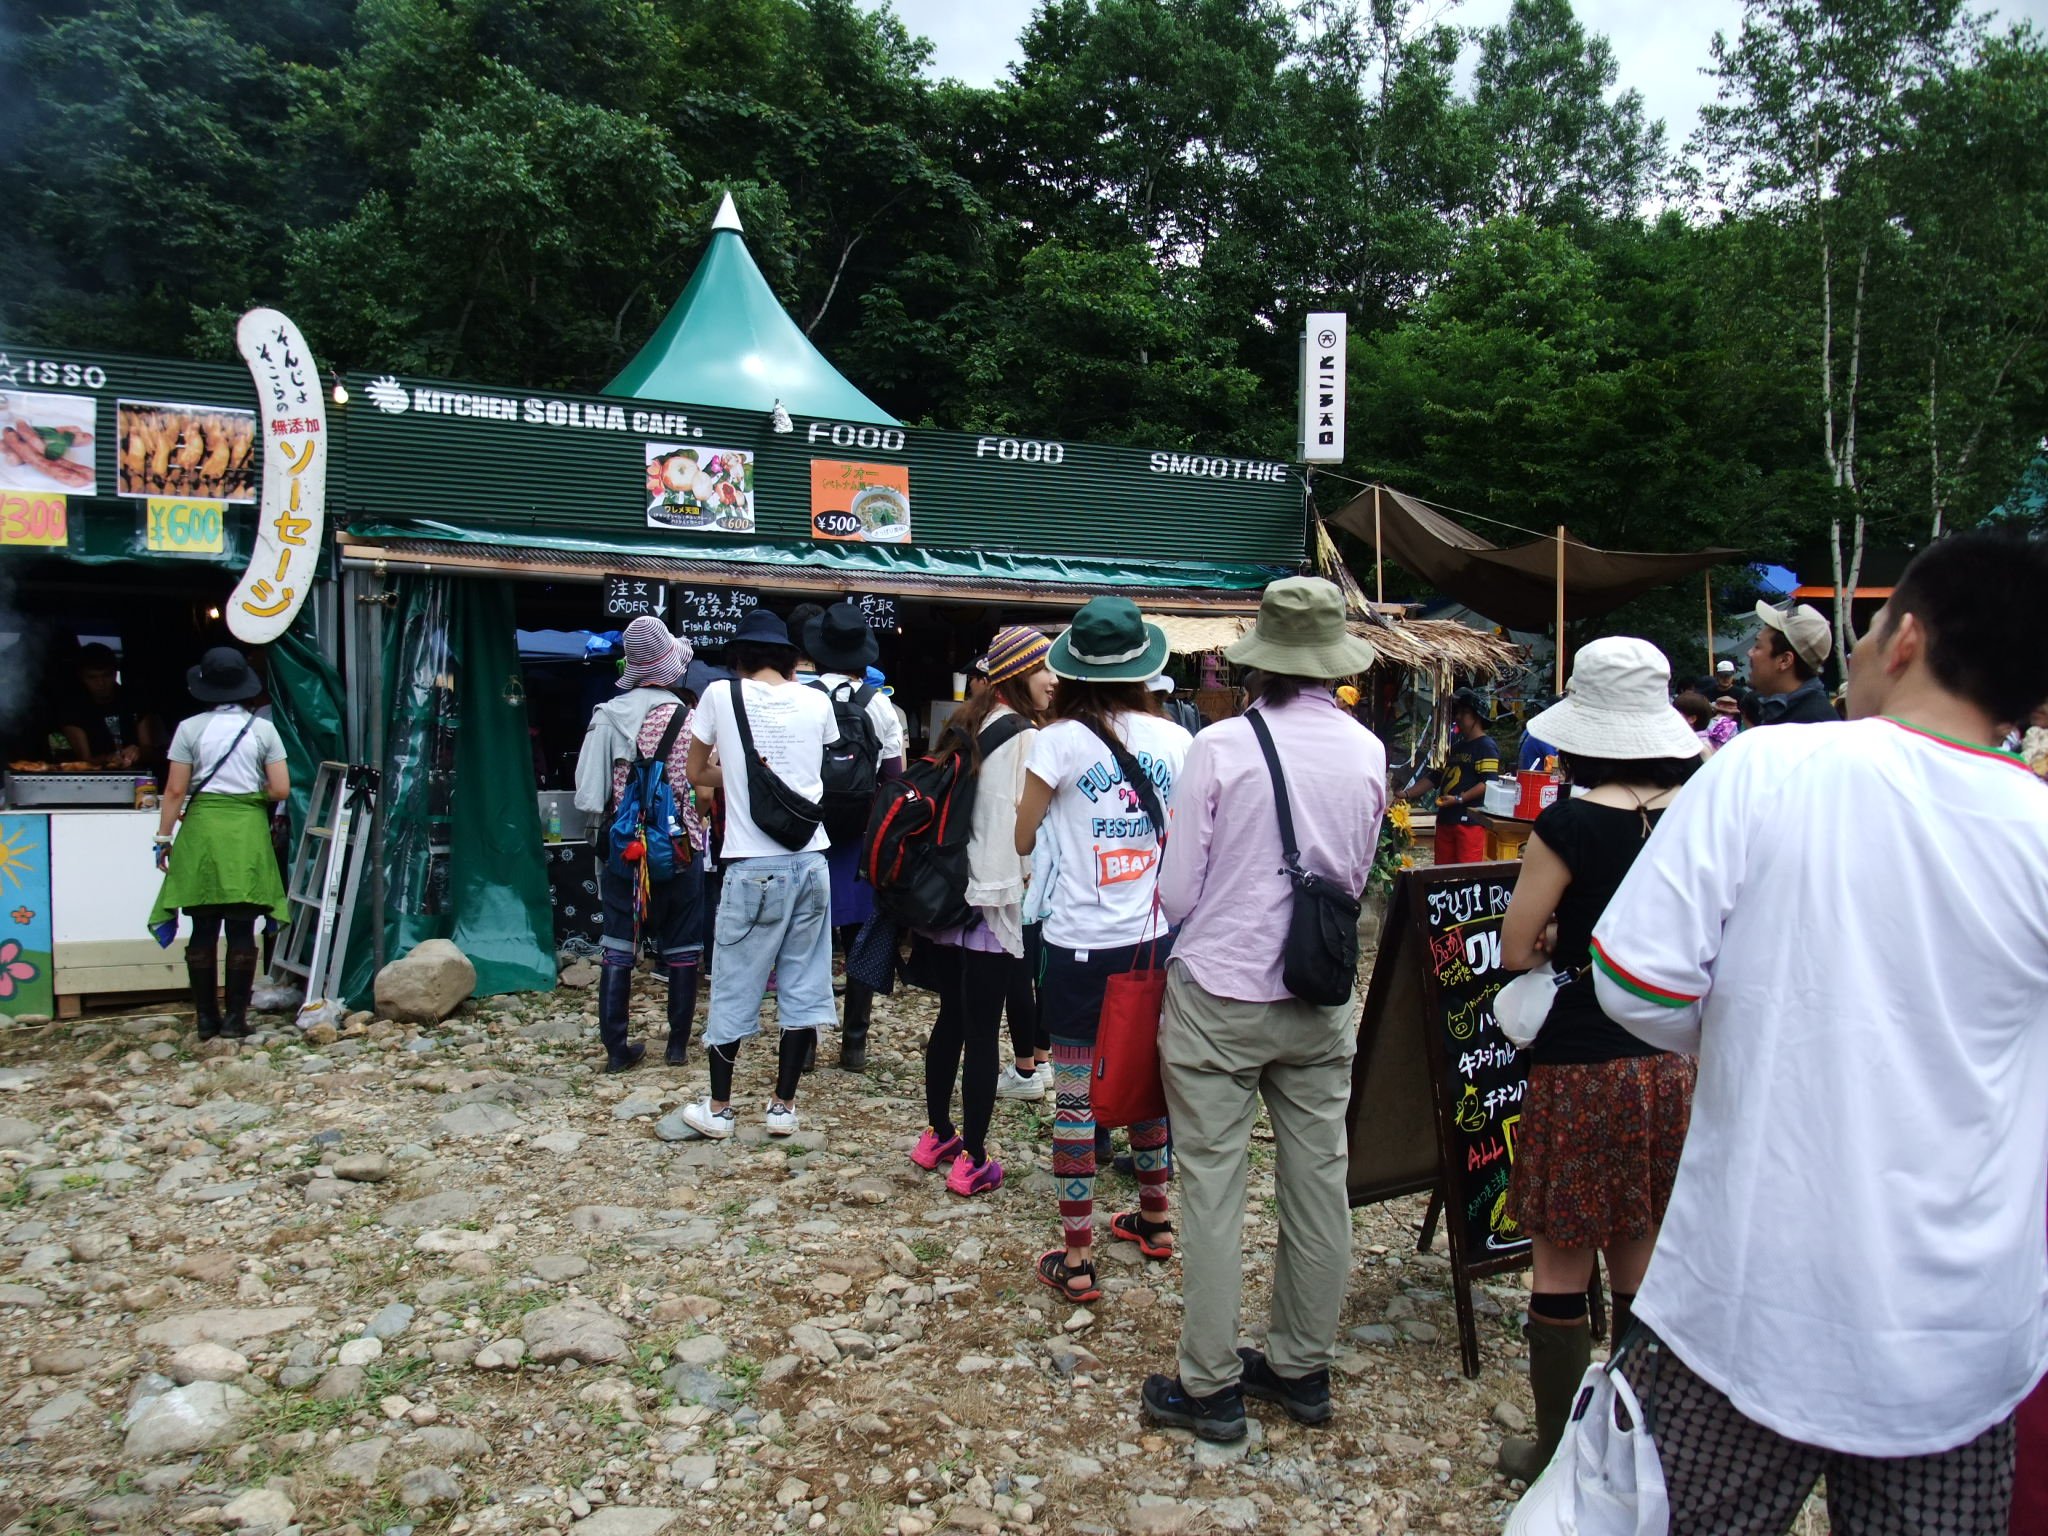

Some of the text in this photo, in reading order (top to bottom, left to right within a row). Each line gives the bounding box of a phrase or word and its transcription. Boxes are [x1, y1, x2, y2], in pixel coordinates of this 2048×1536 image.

[414, 388, 518, 421] KITCHEN
[523, 398, 627, 432] SOLNA
[271, 417, 320, 436] 無添加
[808, 422, 905, 451] FOOD
[977, 437, 1064, 464] FOOD
[1149, 452, 1289, 484] SMOOTHIE
[0, 494, 66, 540] 300
[150, 503, 220, 549] ¥600
[242, 439, 315, 618] ソーセージ
[611, 578, 648, 597] 注文
[684, 590, 758, 606] フィッシュ ¥500
[609, 600, 649, 613] ORDER
[859, 594, 895, 615] 受取
[1076, 753, 1125, 803] FUJ
[1428, 883, 1483, 925] FUJI
[1467, 1136, 1504, 1171] ALL
